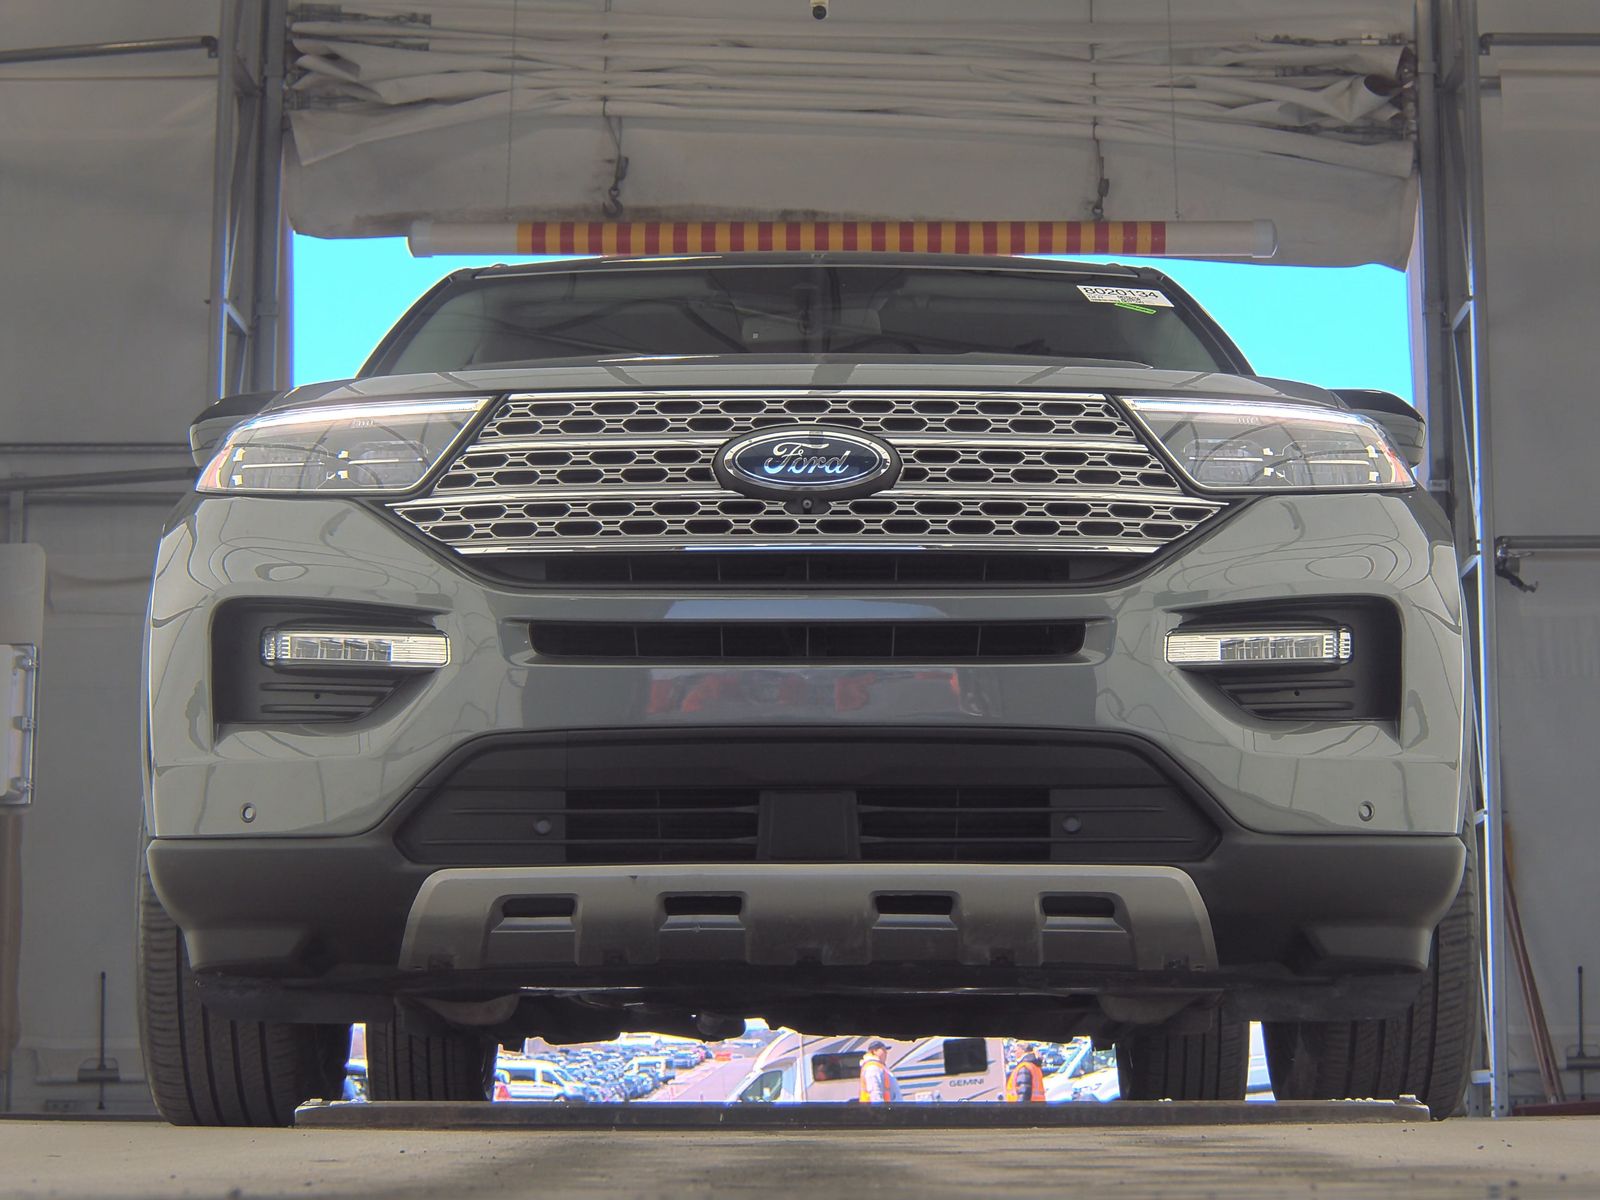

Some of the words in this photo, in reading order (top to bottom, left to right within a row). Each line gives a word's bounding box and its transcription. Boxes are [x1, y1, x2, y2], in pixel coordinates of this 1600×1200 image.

[1083, 287, 1158, 298] 8020134
[763, 442, 851, 474] Ford
[949, 1078, 984, 1087] GEMINI
